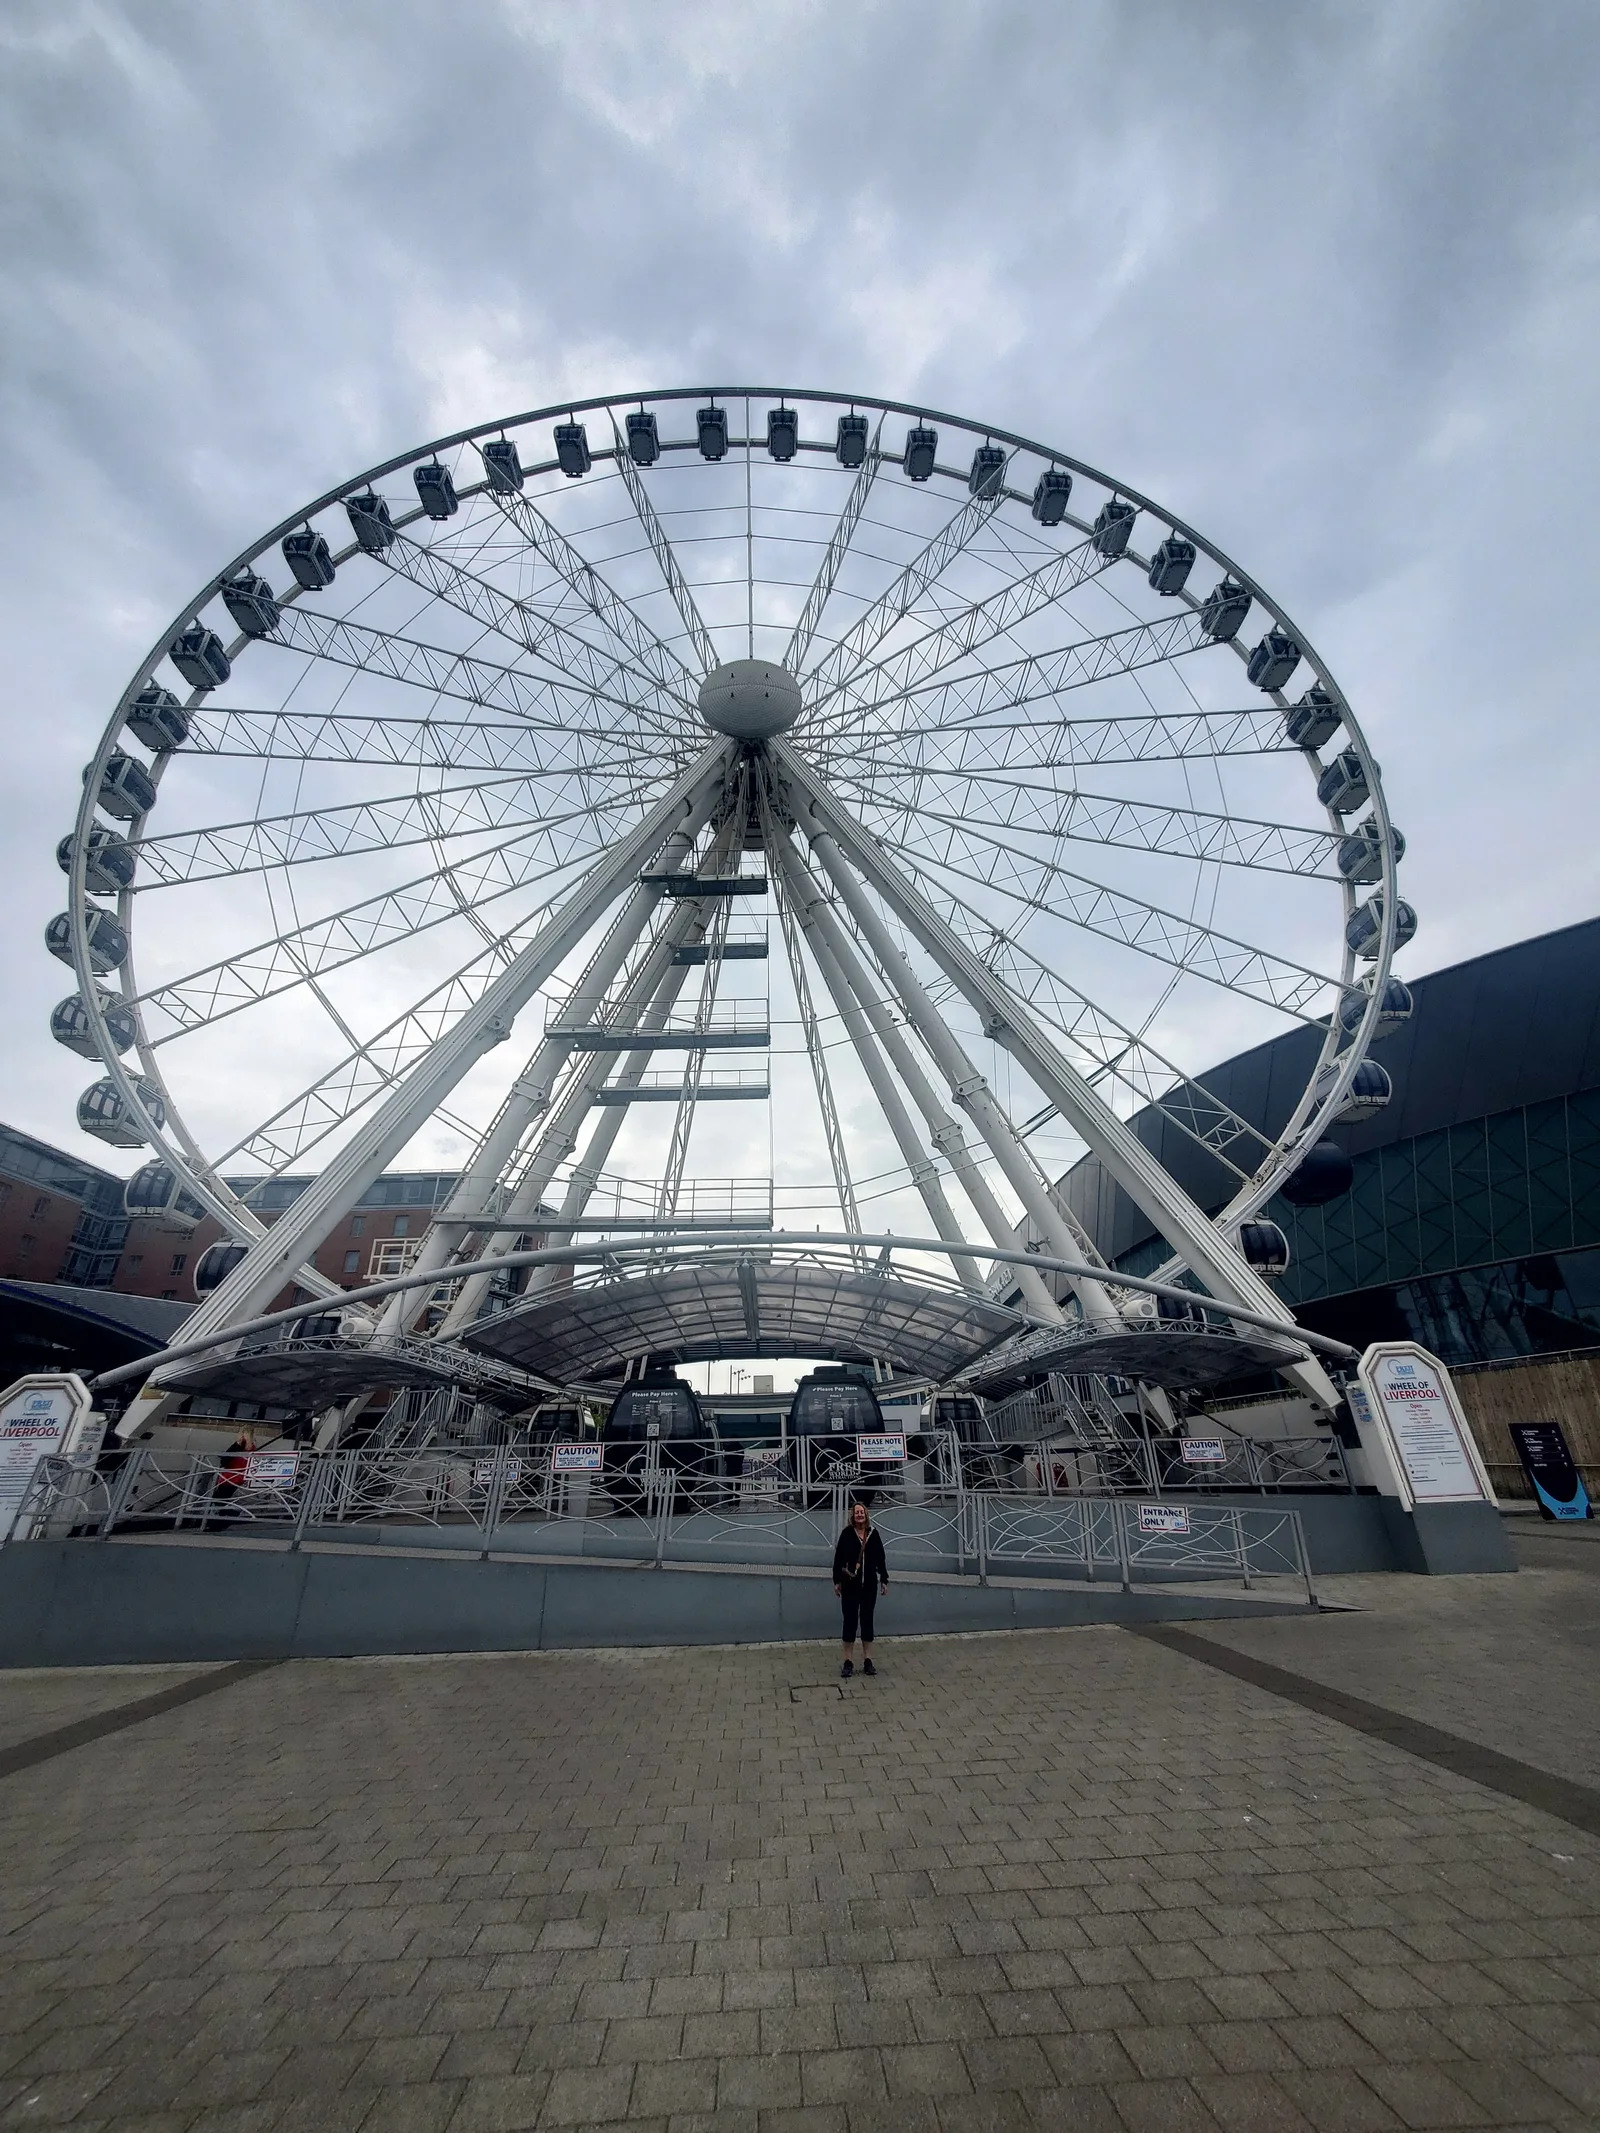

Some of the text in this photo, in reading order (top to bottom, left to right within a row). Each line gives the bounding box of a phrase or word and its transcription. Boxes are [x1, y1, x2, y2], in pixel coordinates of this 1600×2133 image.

[1388, 1381, 1429, 1390] WHEEL OF
[1383, 1389, 1440, 1401] LIVERPOOL
[10, 1418, 58, 1427] WHEEL OF
[0, 1426, 60, 1438] LIVERPOOL
[1184, 1441, 1219, 1449] CAUTION
[557, 1446, 599, 1455] CAUTION
[762, 1452, 780, 1460] EXIT
[1143, 1508, 1183, 1517] ENTRANCE
[1144, 1518, 1165, 1526] ONLY
